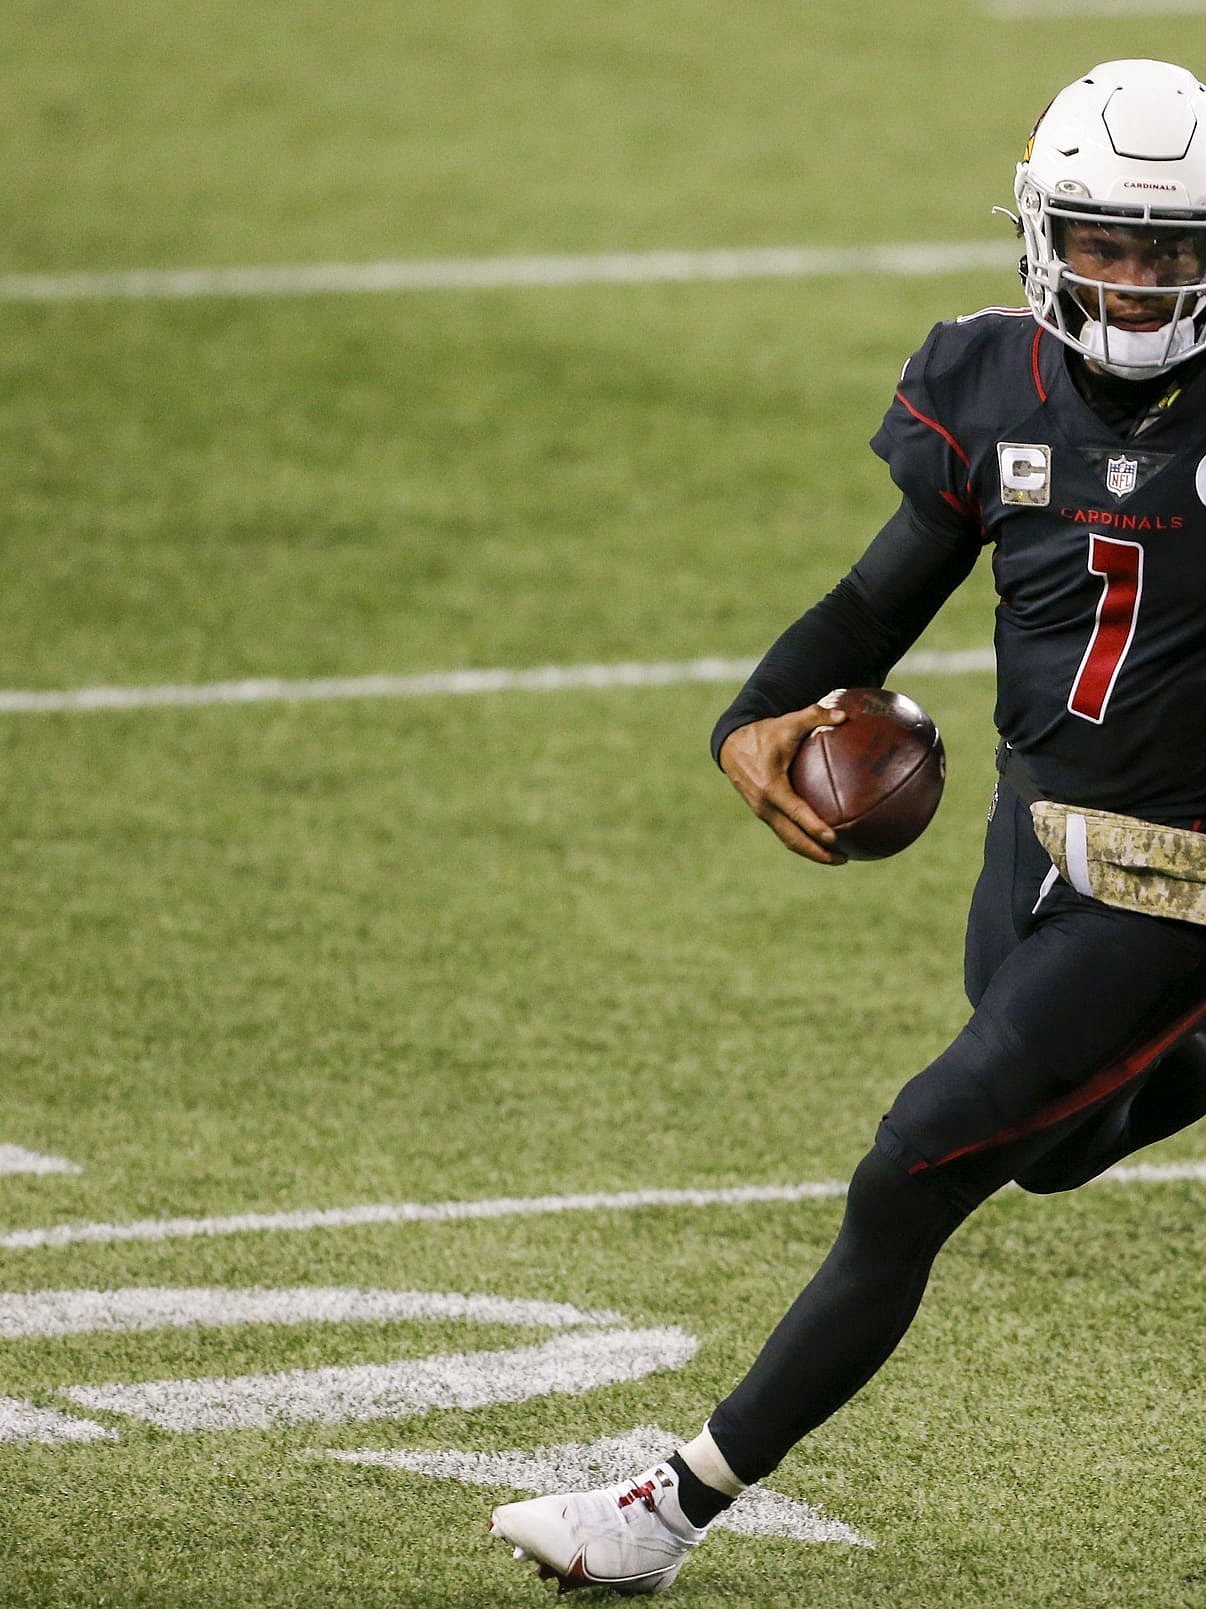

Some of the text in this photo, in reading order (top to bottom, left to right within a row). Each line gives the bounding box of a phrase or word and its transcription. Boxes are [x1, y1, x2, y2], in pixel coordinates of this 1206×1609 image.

[1123, 182, 1177, 191] CARDINALS
[1000, 447, 1046, 490] C
[1111, 473, 1132, 488] NFL
[1060, 507, 1184, 529] CARDINALS
